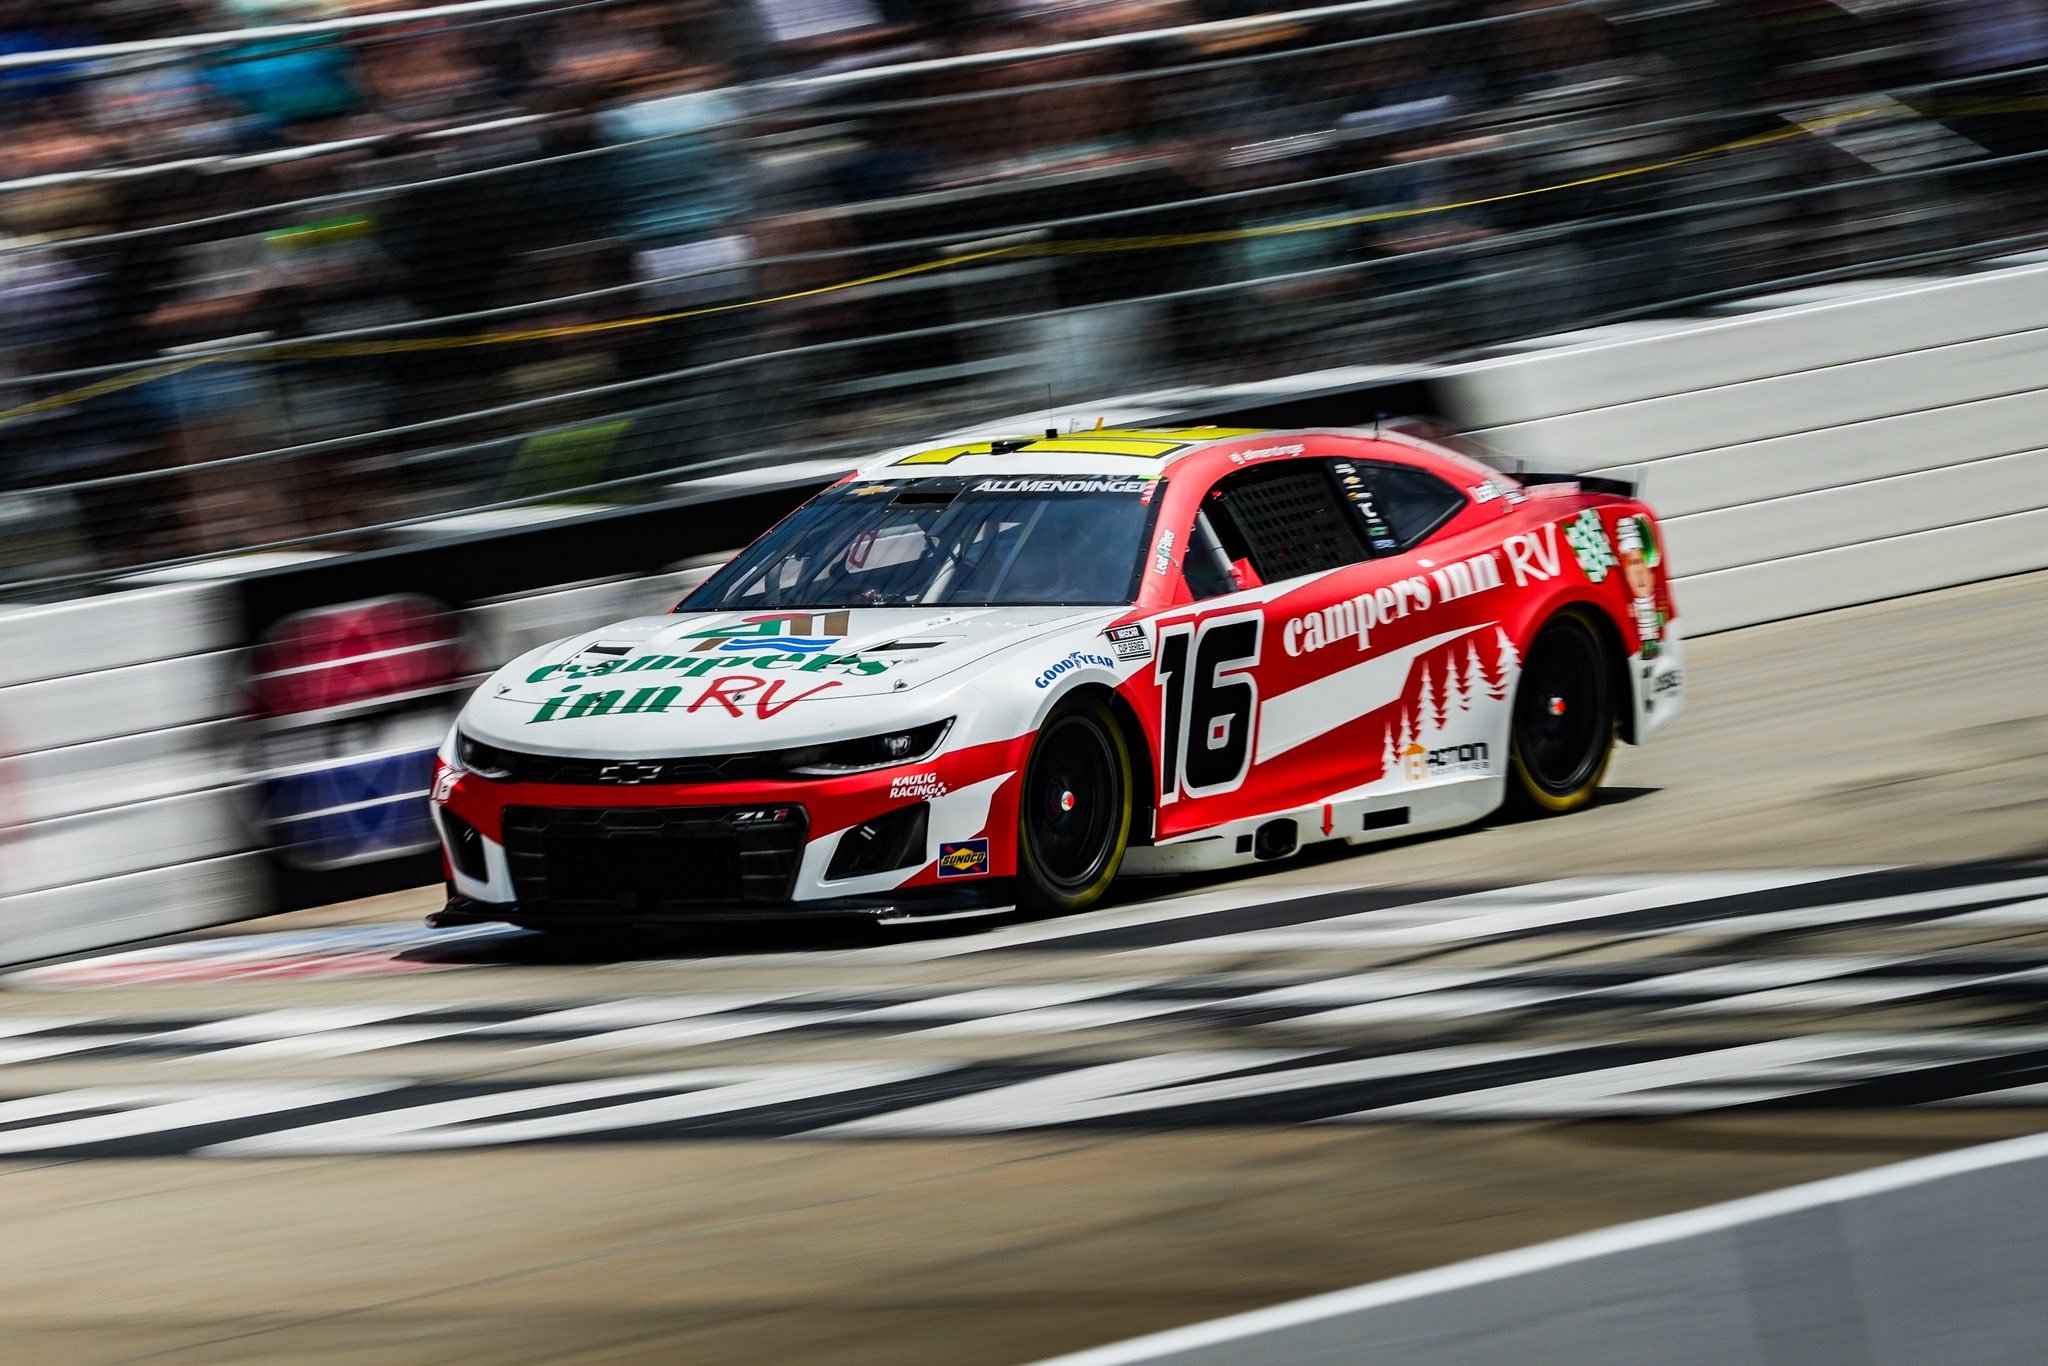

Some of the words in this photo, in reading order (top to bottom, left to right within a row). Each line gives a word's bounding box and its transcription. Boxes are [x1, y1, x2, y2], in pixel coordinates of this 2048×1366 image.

[1283, 575, 1432, 657] campers
[1416, 553, 1505, 604] inn
[1502, 522, 1561, 587] RV
[1117, 643, 1128, 653] CUP
[1127, 640, 1145, 652] SERIES
[526, 653, 902, 683] campers
[525, 684, 682, 724] inn
[687, 675, 843, 720] RV
[1156, 611, 1263, 803] 16
[892, 773, 936, 786] KAULIG
[889, 784, 936, 799] RACING
[731, 808, 789, 824] ZL1
[941, 852, 986, 866] SUNOCO
